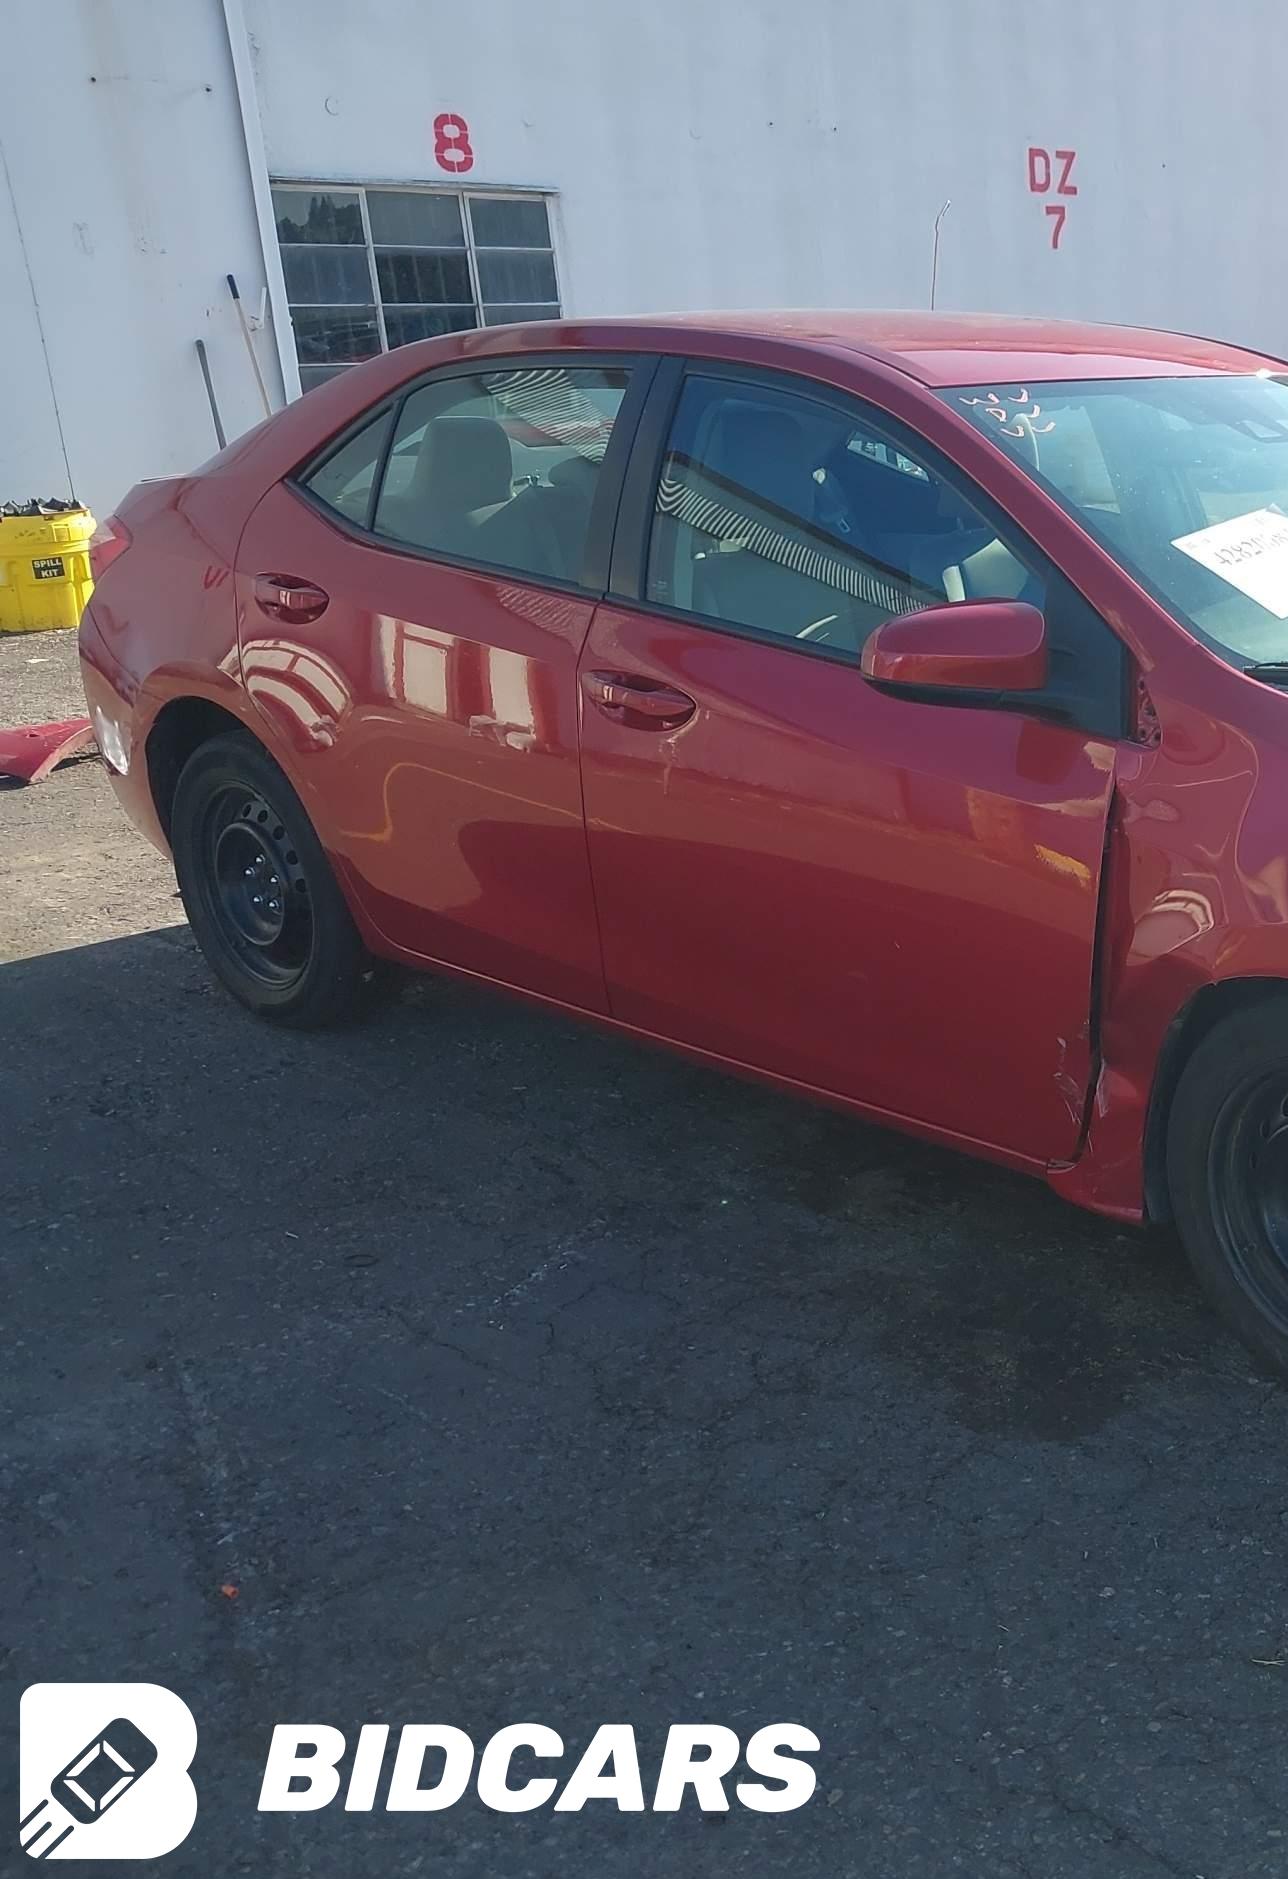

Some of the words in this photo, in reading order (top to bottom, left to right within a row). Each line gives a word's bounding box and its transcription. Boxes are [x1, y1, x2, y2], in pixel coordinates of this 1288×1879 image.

[433, 113, 474, 173] 8
[1028, 147, 1078, 195] DZ
[1045, 205, 1066, 249] 7
[33, 558, 62, 569] SPILL
[40, 569, 59, 578] KIT
